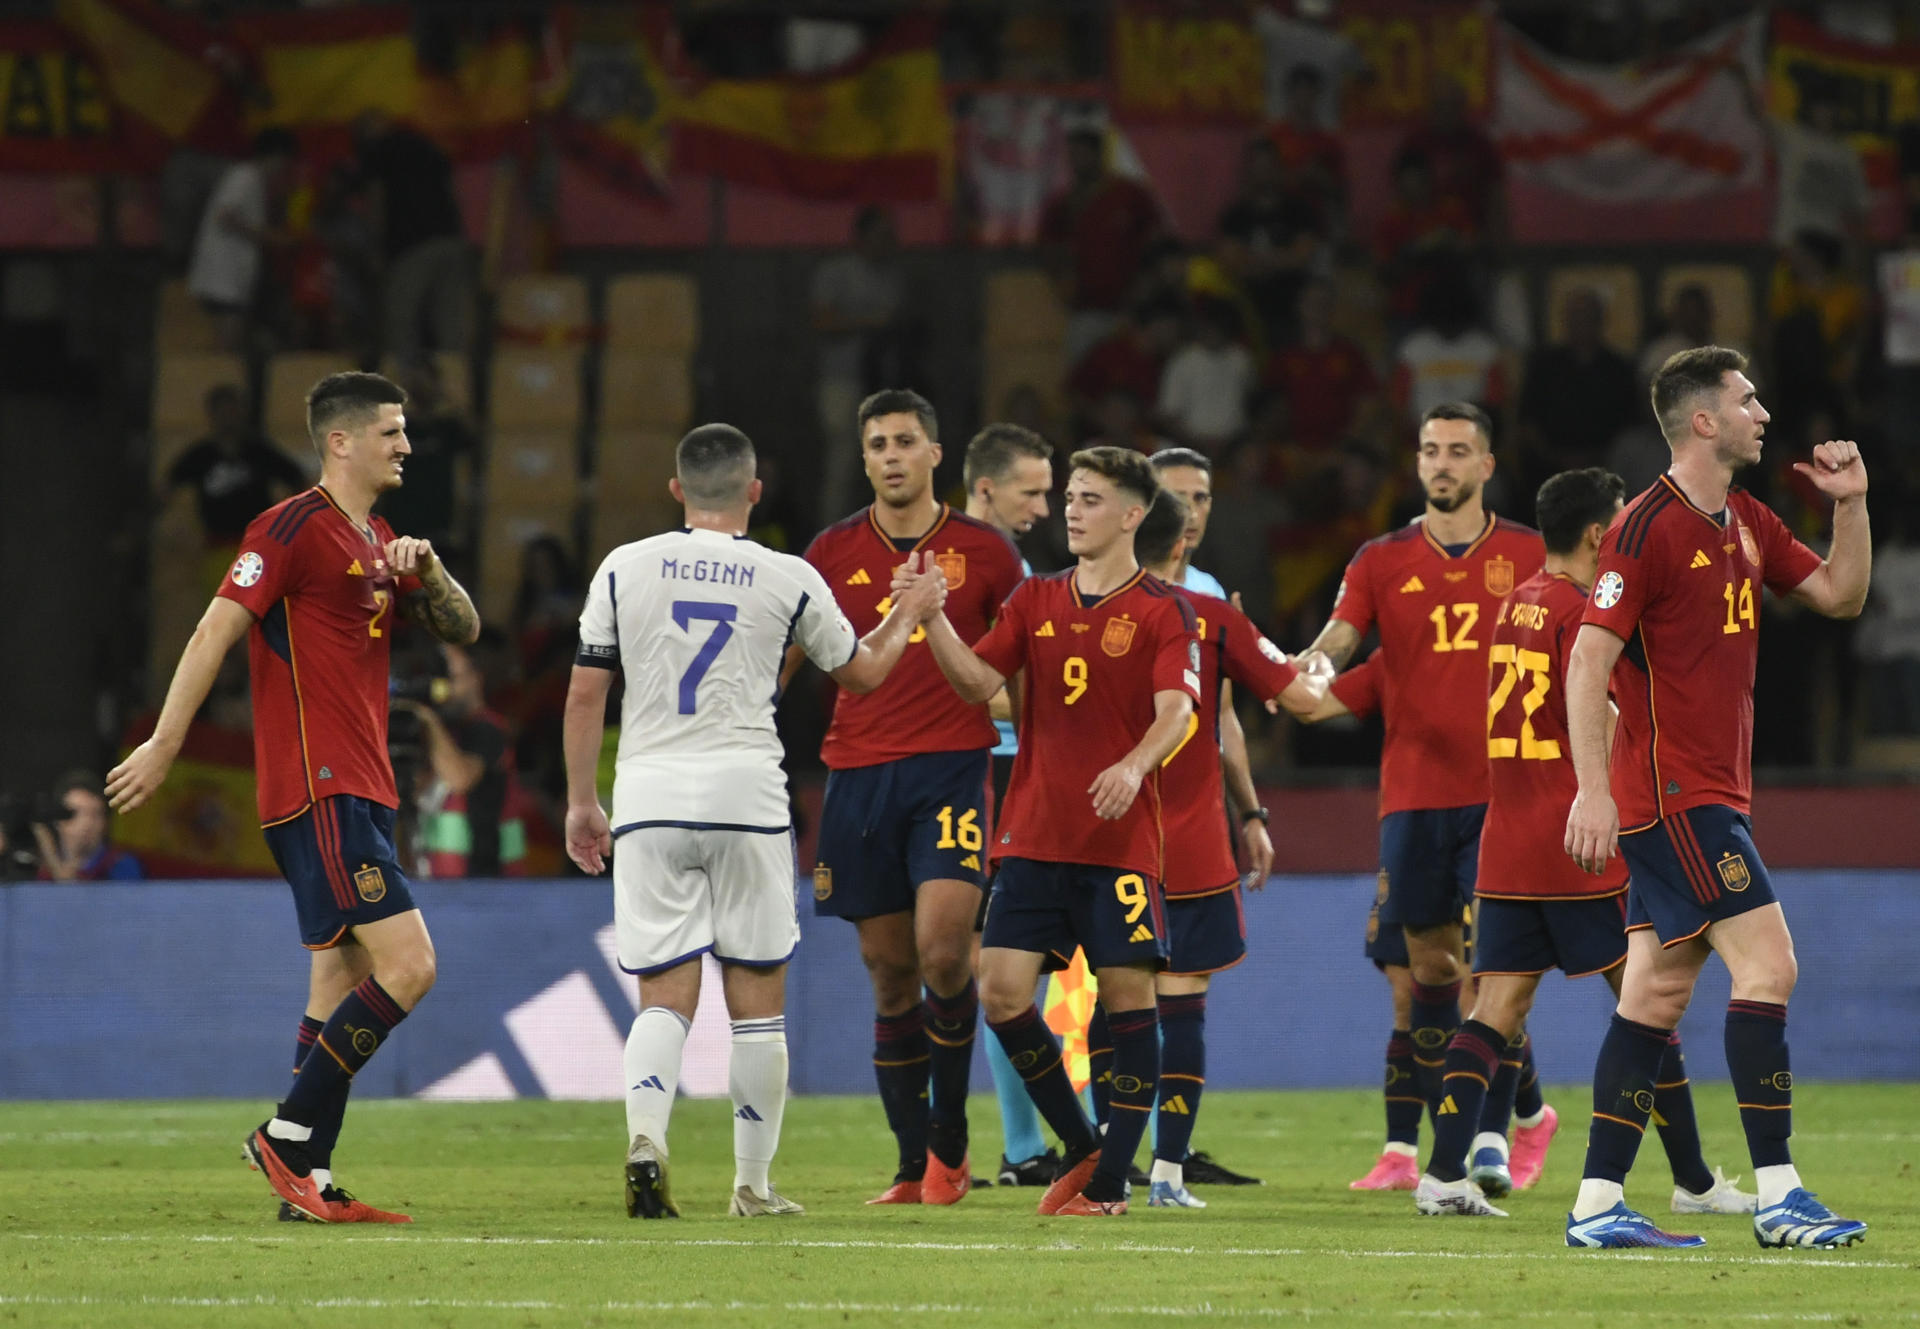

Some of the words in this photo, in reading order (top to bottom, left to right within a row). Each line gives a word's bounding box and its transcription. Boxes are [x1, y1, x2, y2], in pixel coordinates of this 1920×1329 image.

[662, 558, 755, 588] McGINN
[369, 590, 389, 638] 2
[1429, 602, 1479, 653] 12
[1723, 578, 1755, 635] 14
[672, 601, 737, 715] 7
[1063, 656, 1088, 705] 9
[1487, 644, 1562, 761] 22
[936, 805, 983, 852] 16
[1114, 873, 1148, 925] 9
